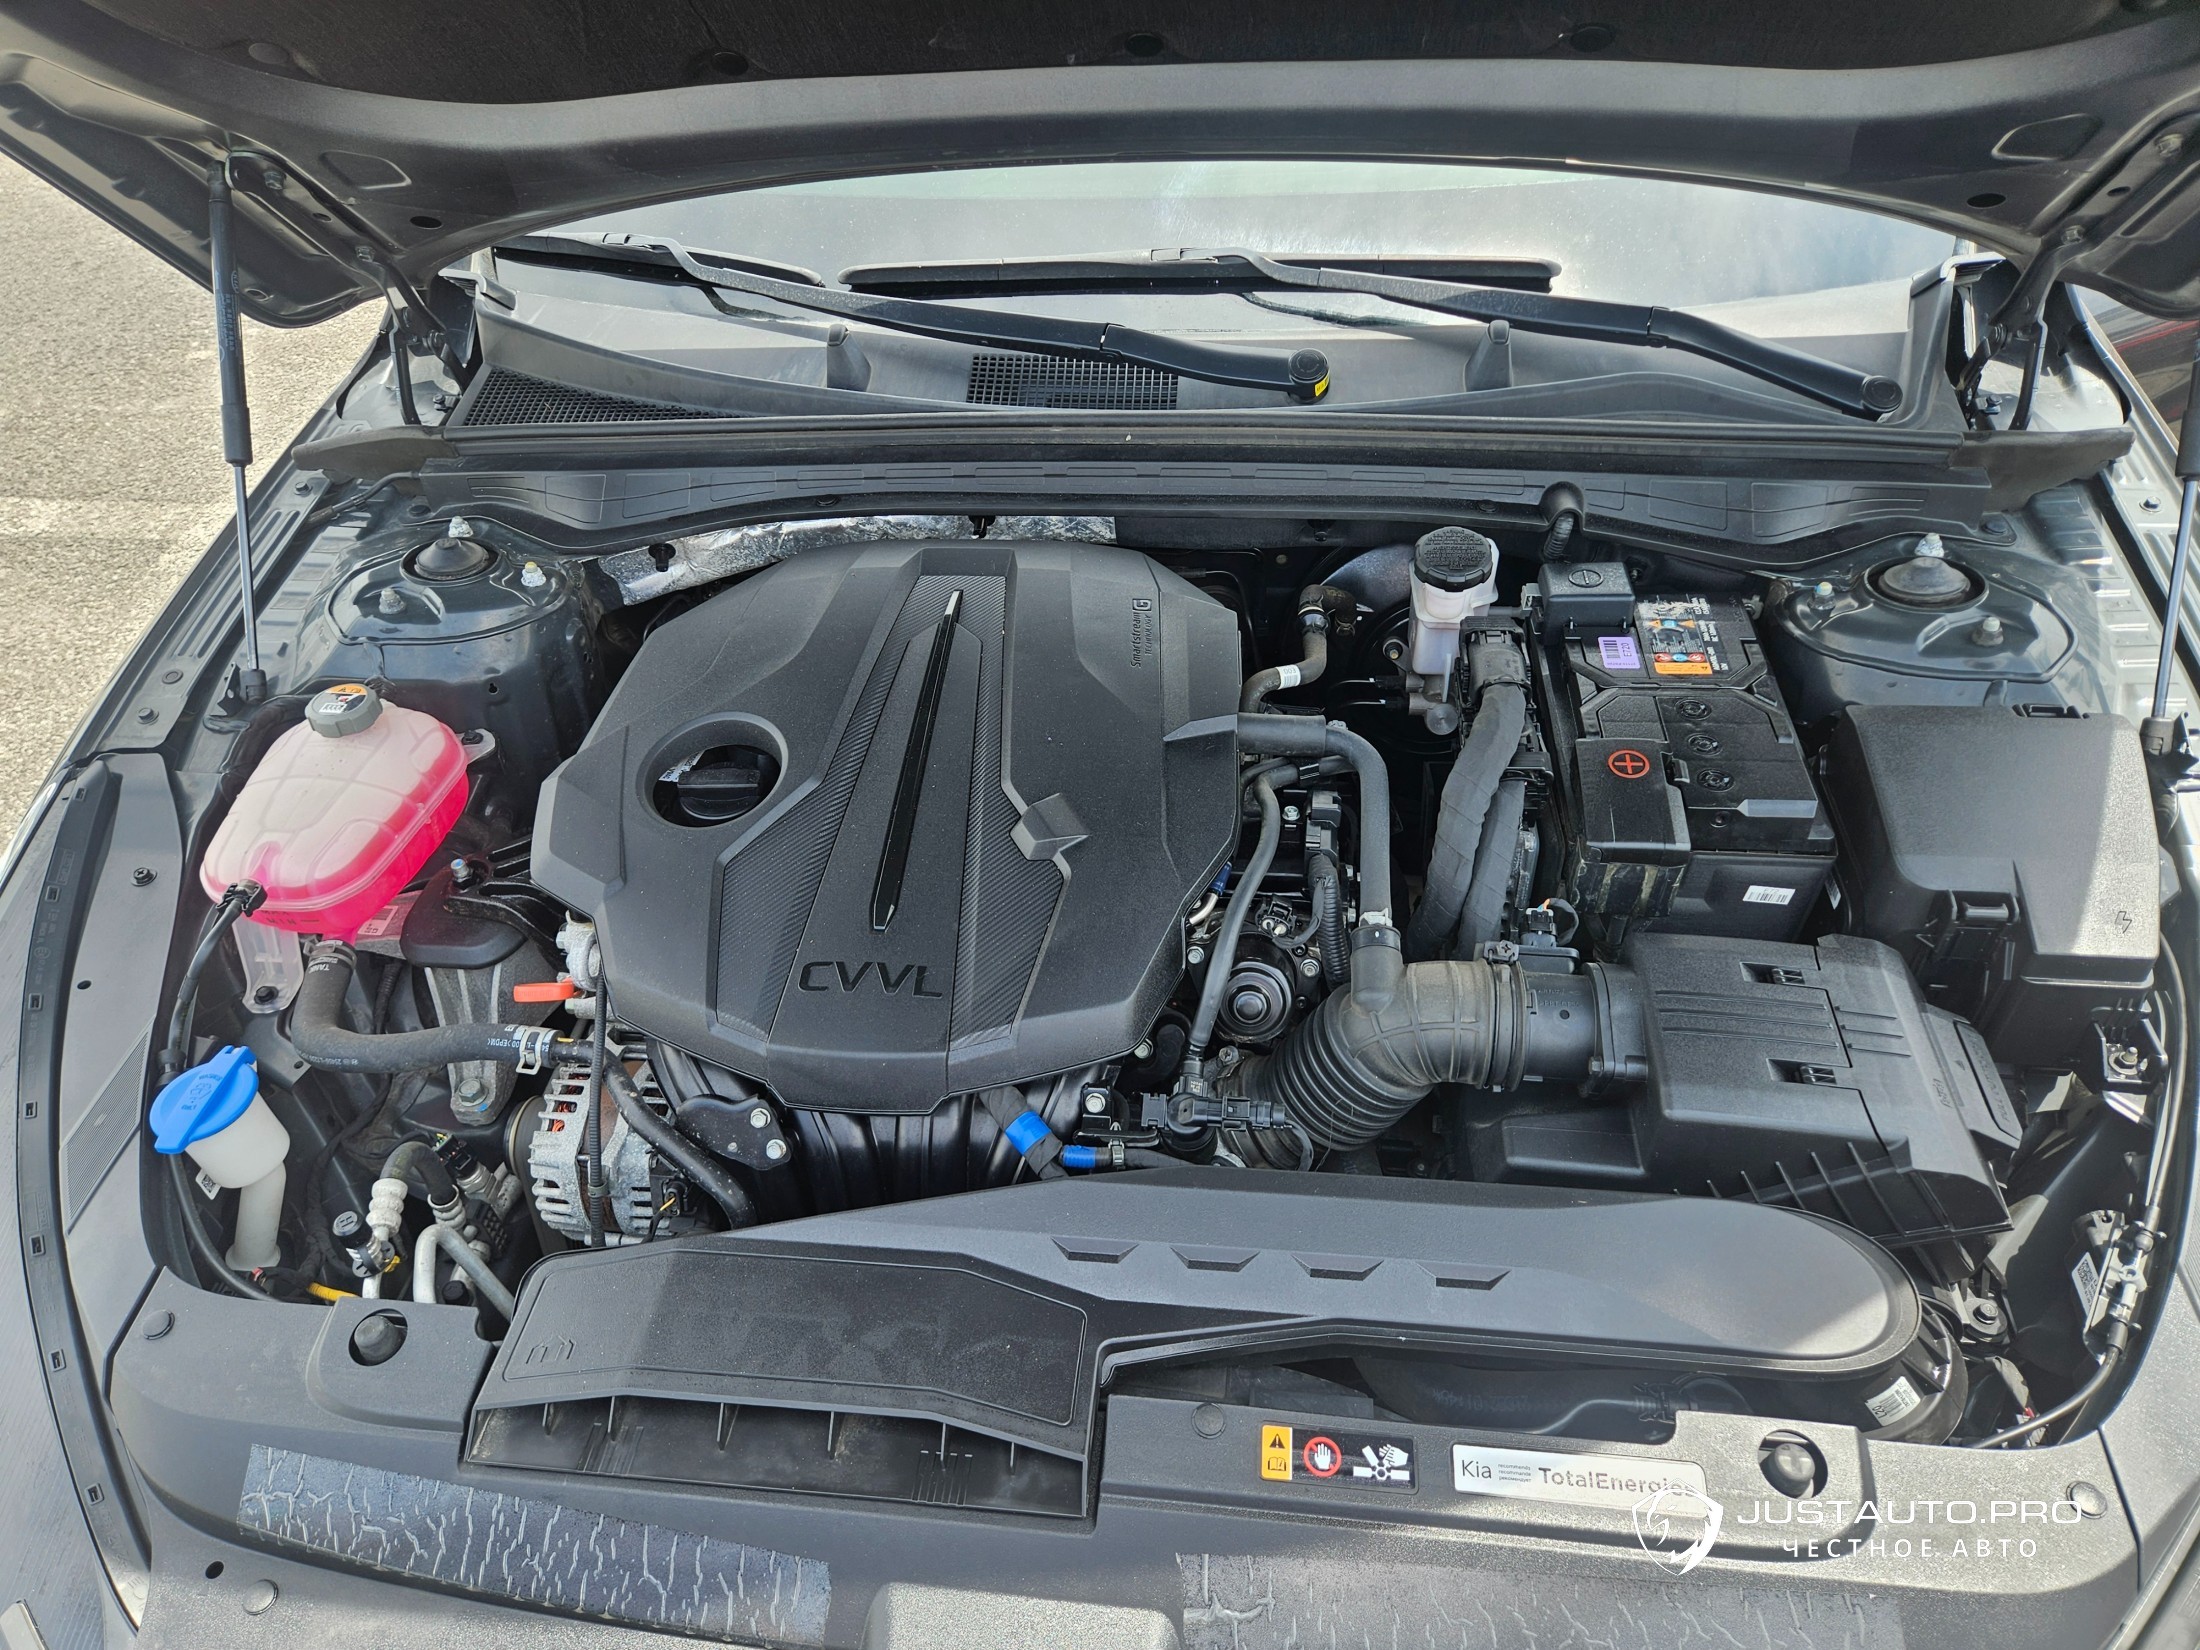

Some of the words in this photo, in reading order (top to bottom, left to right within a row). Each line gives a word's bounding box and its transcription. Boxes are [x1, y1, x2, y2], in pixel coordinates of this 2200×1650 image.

[1130, 612, 1142, 668] Smartstream
[797, 961, 943, 999] CVVL
[1461, 1459, 1493, 1480] Kia
